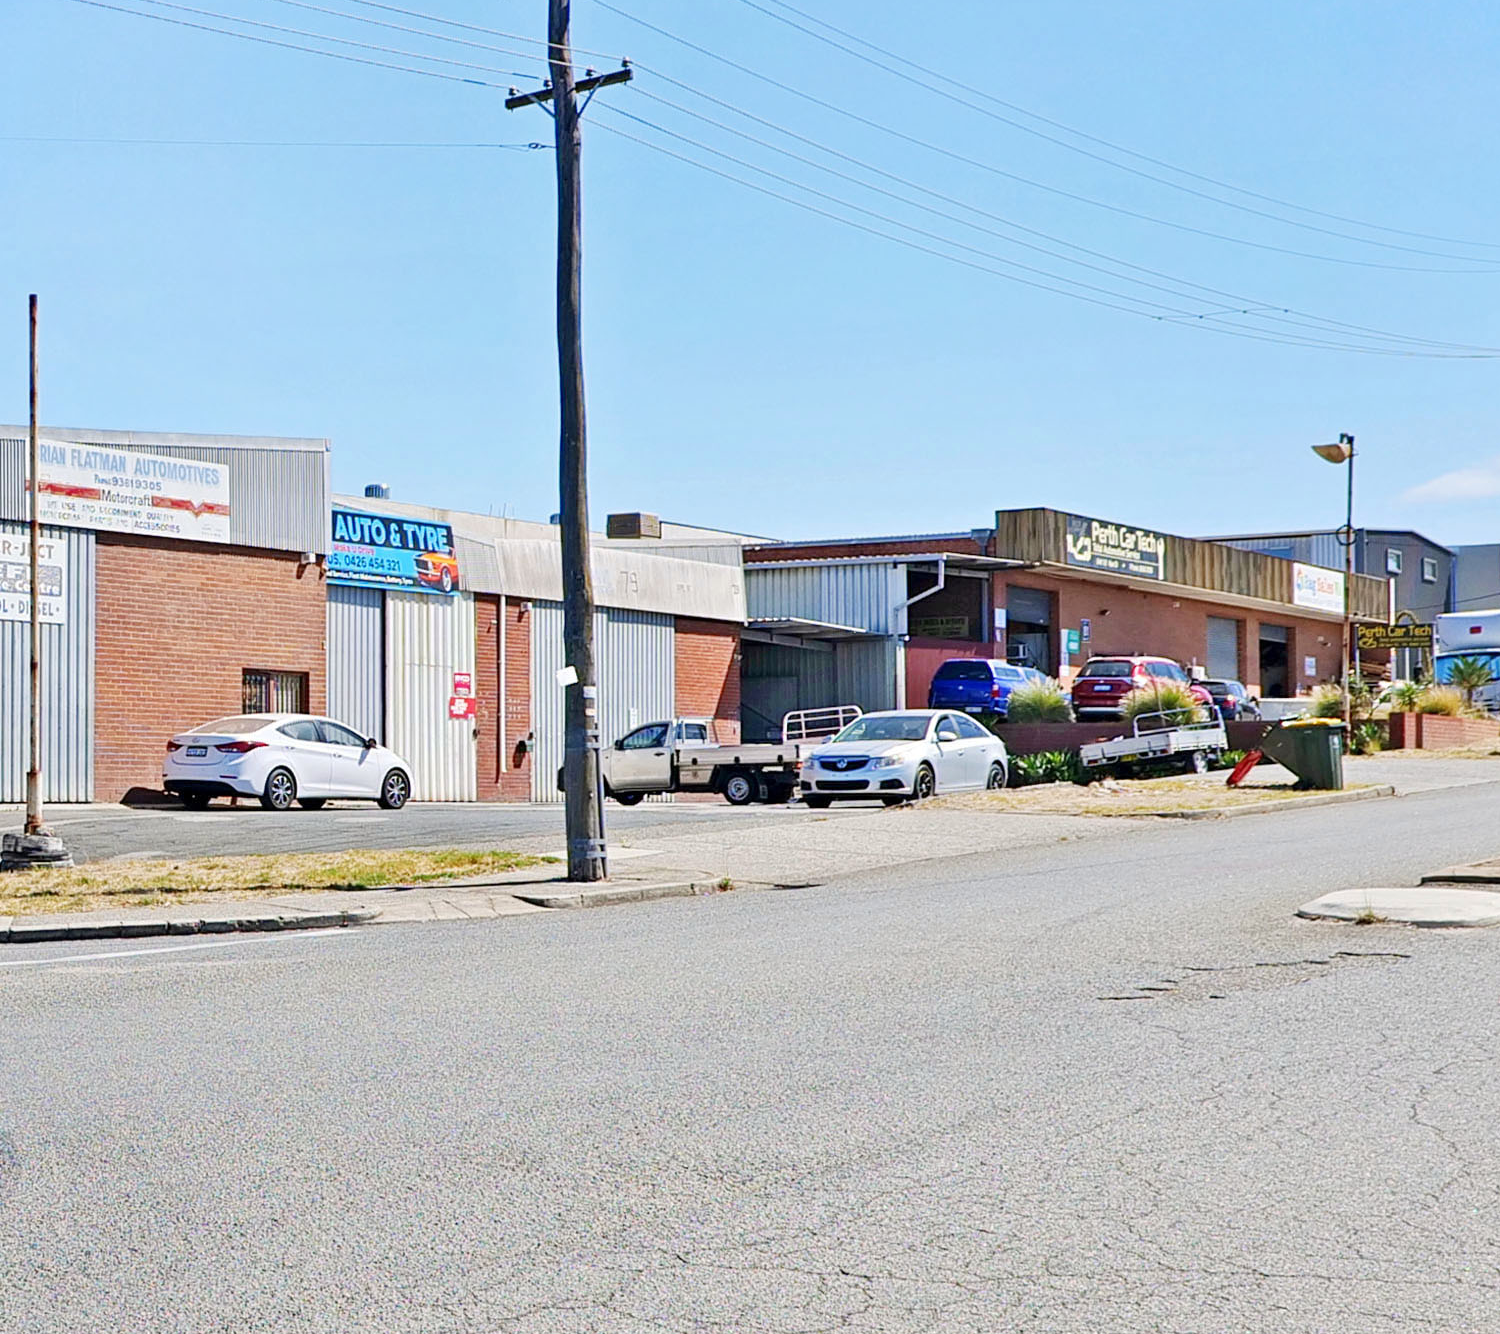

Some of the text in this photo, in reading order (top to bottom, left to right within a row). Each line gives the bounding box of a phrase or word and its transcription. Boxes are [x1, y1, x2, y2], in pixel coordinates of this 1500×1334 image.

[39, 444, 220, 485] RIAN FLATMAN AUTOMOTIVES
[101, 489, 152, 507] Motorcraft
[335, 514, 450, 552] AUTO & TYRE
[1091, 521, 1157, 553] Perth Car Tech
[344, 554, 367, 568] 0426
[369, 557, 386, 570] 454
[386, 559, 401, 572] 321
[15, 579, 59, 594] Cetre
[18, 600, 54, 617] DIEL
[1359, 625, 1432, 637] Perth Car Tech
